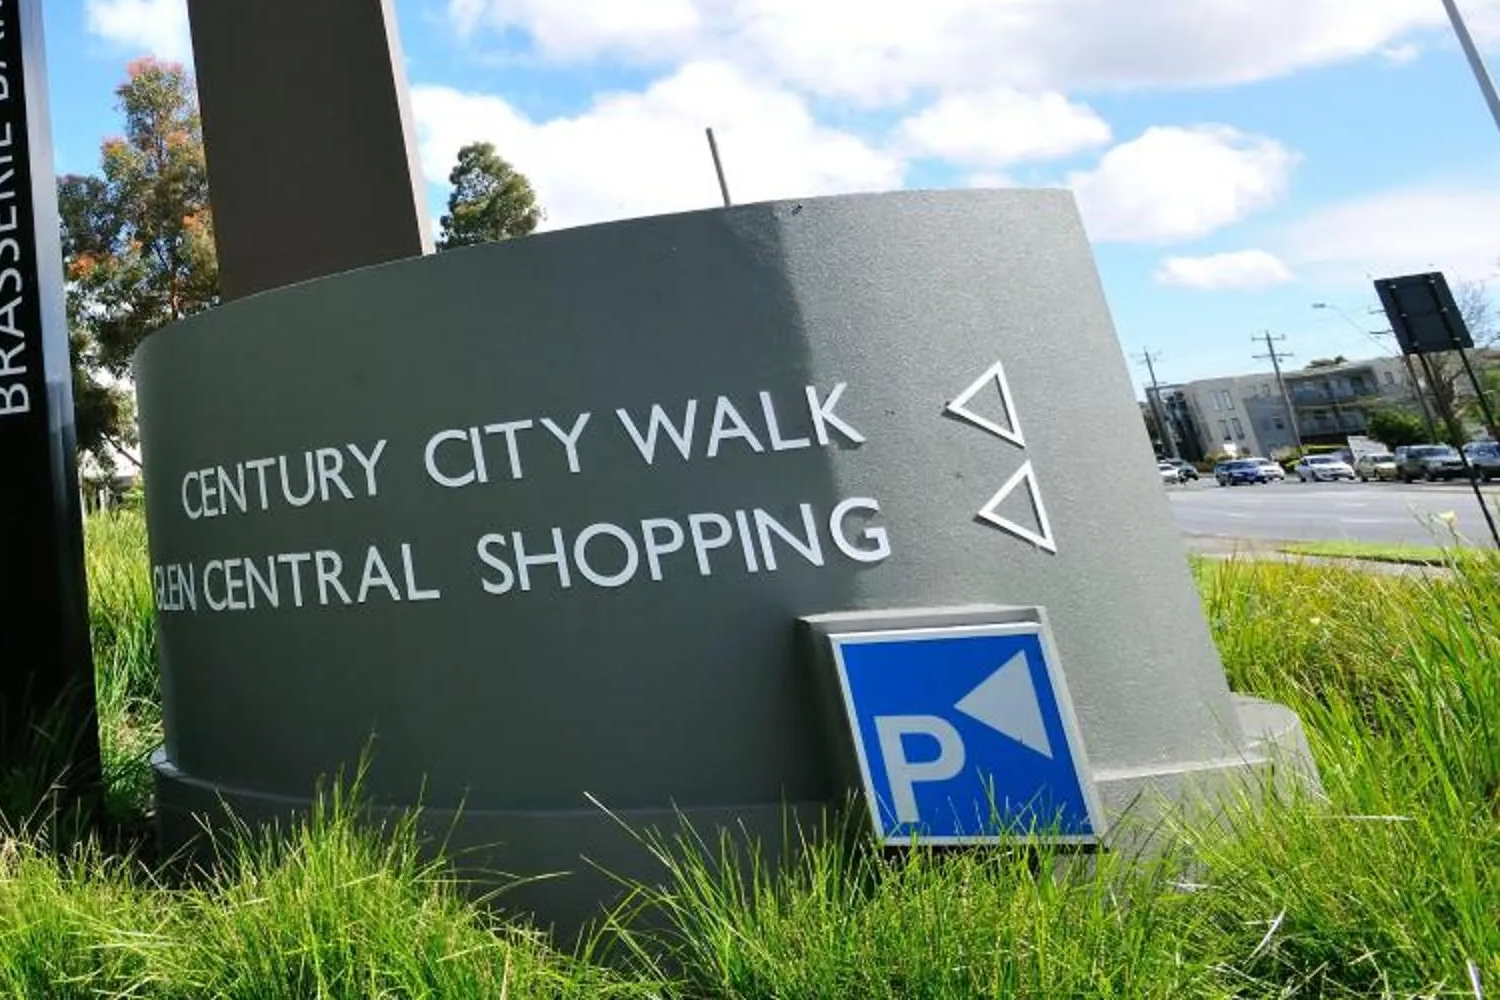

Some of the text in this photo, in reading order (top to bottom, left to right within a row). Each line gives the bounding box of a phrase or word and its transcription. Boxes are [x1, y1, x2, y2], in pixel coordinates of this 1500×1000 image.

[182, 382, 867, 519] CENTURY CITY WALK
[203, 543, 441, 612] CENTRAL
[476, 497, 891, 595] SHOPPING
[873, 714, 966, 824] P
